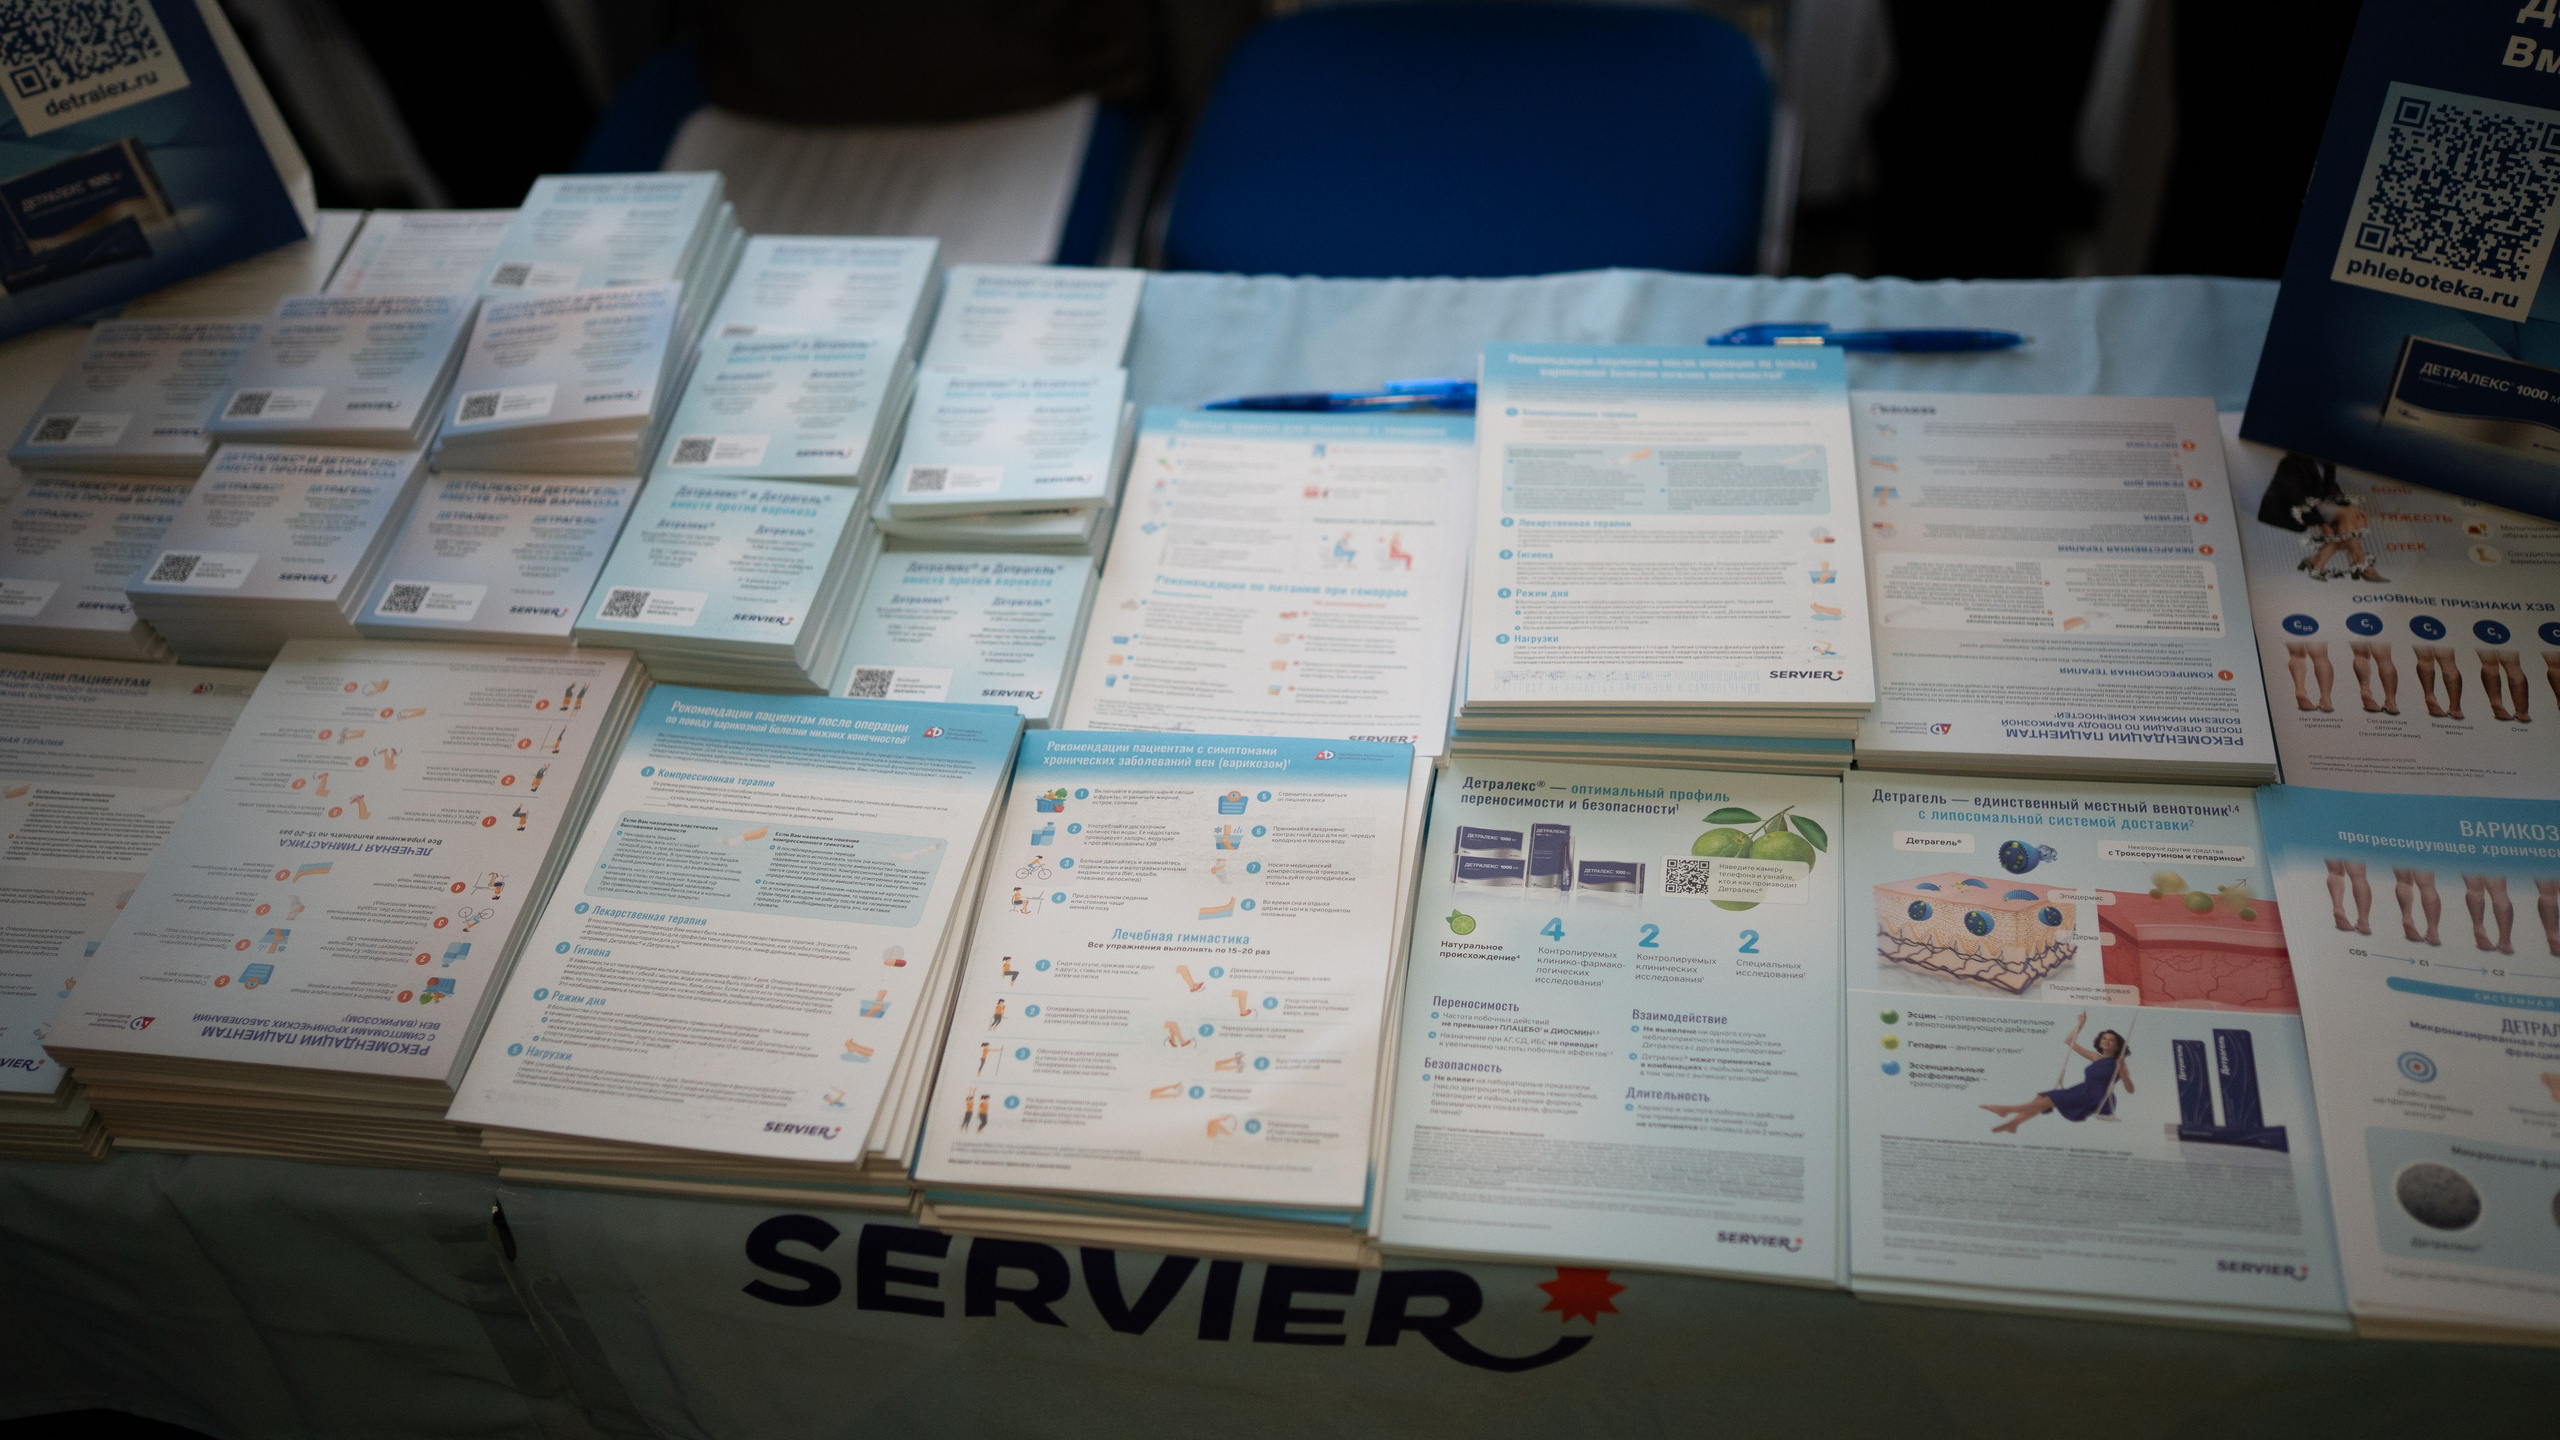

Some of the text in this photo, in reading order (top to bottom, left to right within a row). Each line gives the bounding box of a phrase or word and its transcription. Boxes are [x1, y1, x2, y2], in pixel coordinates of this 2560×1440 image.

[45, 71, 158, 117] detralex.ru
[2347, 259, 2519, 309] phleboteka.ru
[2516, 384, 2549, 401] 1000
[2386, 542, 2427, 553] ОТЕК
[1516, 551, 1553, 560] Гигиена
[278, 572, 338, 585] SERVIER
[1516, 588, 1569, 599] Режим дня
[2352, 594, 2555, 612] ОСНОВНЫЕ ПРИЗНАКИ ХЗВ
[508, 604, 569, 618] SERVIER
[732, 612, 794, 626] SERVIER
[1514, 635, 1559, 645] Нагрузки
[69, 673, 151, 688] ПАЦИЕНТАМ
[1769, 670, 1844, 681] SERVIER
[2059, 667, 2214, 679] КОМПРЕССИОННАЯ ТЕРАПИЯ
[981, 689, 1044, 700] SERVIER
[671, 701, 909, 734] Рекомендации пациентам после операции
[2001, 719, 2075, 729] ВАРИКОЗНОЙ
[2139, 715, 2241, 724] БОЛЕЗНИ НИЖНИХ
[665, 717, 678, 726] по
[679, 718, 711, 731] поводу
[713, 719, 768, 735] варикозной
[769, 724, 807, 736] болезни
[809, 729, 845, 739] нижних
[2077, 721, 2122, 730] ПОВОДУ
[2143, 724, 2202, 733] ОПЕРАЦИИ
[2205, 726, 2242, 734] ПОСЛЕ
[1348, 734, 1418, 744] SERVIER
[2006, 728, 2245, 746] РЕКОМЕНДАЦИИ ПАЦИЕНТАМ
[1047, 741, 1130, 755] Рекомендации
[1133, 745, 1194, 756] пациентам
[1207, 747, 1277, 755] симптомами
[1043, 758, 1116, 769] хронических
[1118, 757, 1192, 767] заболеваний
[1195, 760, 1215, 768] вен
[658, 768, 775, 788] Компрессионная терапия
[1571, 781, 1664, 797] оптимальный
[1669, 786, 1730, 803] профиль
[1461, 796, 1564, 811] переносимости
[1568, 801, 1577, 810] и
[1872, 789, 1946, 806] Детрагель
[1974, 793, 2079, 812] единственный
[2084, 798, 2147, 812] местный
[1931, 808, 2043, 824] липосомальной
[2048, 813, 2117, 827] системой
[279, 839, 433, 857] ЛЕЧЕБНАЯ ГИМНАСТИКА
[2127, 843, 2166, 853] Некоторые
[2192, 848, 2224, 856] средства
[2338, 830, 2476, 854] прогрессирующее
[2116, 849, 2184, 861] Троксерутином
[1584, 867, 1613, 875] ДЕТРАЛЕКС
[1719, 863, 1755, 871] Наведите
[2059, 892, 2104, 902] Эпидермис
[591, 906, 707, 928] Лекарственная терапия
[1112, 928, 1250, 943] Лечебная гимнастика
[1540, 917, 1566, 942] 4
[1639, 923, 1660, 948] 2
[1441, 940, 1504, 951] Натуральное
[1738, 929, 1760, 954] 2
[2072, 933, 2099, 943] Дерма
[572, 944, 611, 959] Гигиена
[1087, 942, 1103, 950] Все
[1105, 944, 1161, 953] упражнения
[1228, 946, 1252, 954] 15-20
[1538, 946, 1618, 959] Контролируемых
[1537, 956, 1626, 969] клинико-фармако-
[1636, 953, 1717, 965] Контролируемых
[1736, 958, 1802, 970] Специальных
[1535, 966, 1590, 977] логических
[1635, 963, 1698, 973] клинических
[2049, 983, 2132, 995] Подкожно-жировая
[552, 990, 606, 1008] Режим дня
[1432, 995, 1520, 1012] Переносимость
[2070, 993, 2112, 1002] клетчатка
[2475, 992, 2555, 1008] СИСТЕМНАЯ
[192, 1014, 269, 1028] ЗАБОЛЕВАНИЙ
[1443, 1012, 1550, 1026] Частота побочных действий
[1632, 1009, 1728, 1025] Взаимодействие
[1906, 1011, 2056, 1028] Эсцин противовоспалительное
[271, 1019, 349, 1034] ХРОНИЧЕСКИХ
[350, 1025, 425, 1041] СИМПТОМАМИ
[2410, 1020, 2536, 1047] Микронизированная
[201, 1026, 430, 1056] РЕКОМЕНДАЦИИ ПАЦИЕНТАМ
[525, 1046, 573, 1061] Нагрузки
[2220, 1035, 2233, 1077] Детрагель
[1424, 1058, 1503, 1074] Безопасность
[1909, 1062, 1985, 1075] Эссенциальные
[1625, 1087, 1711, 1103] Длительность
[763, 1121, 840, 1140] SERVIER
[1717, 1230, 1802, 1253] SERVIER
[2217, 1259, 2308, 1281] SERVIER
[741, 1214, 1593, 1373] SERVIER
